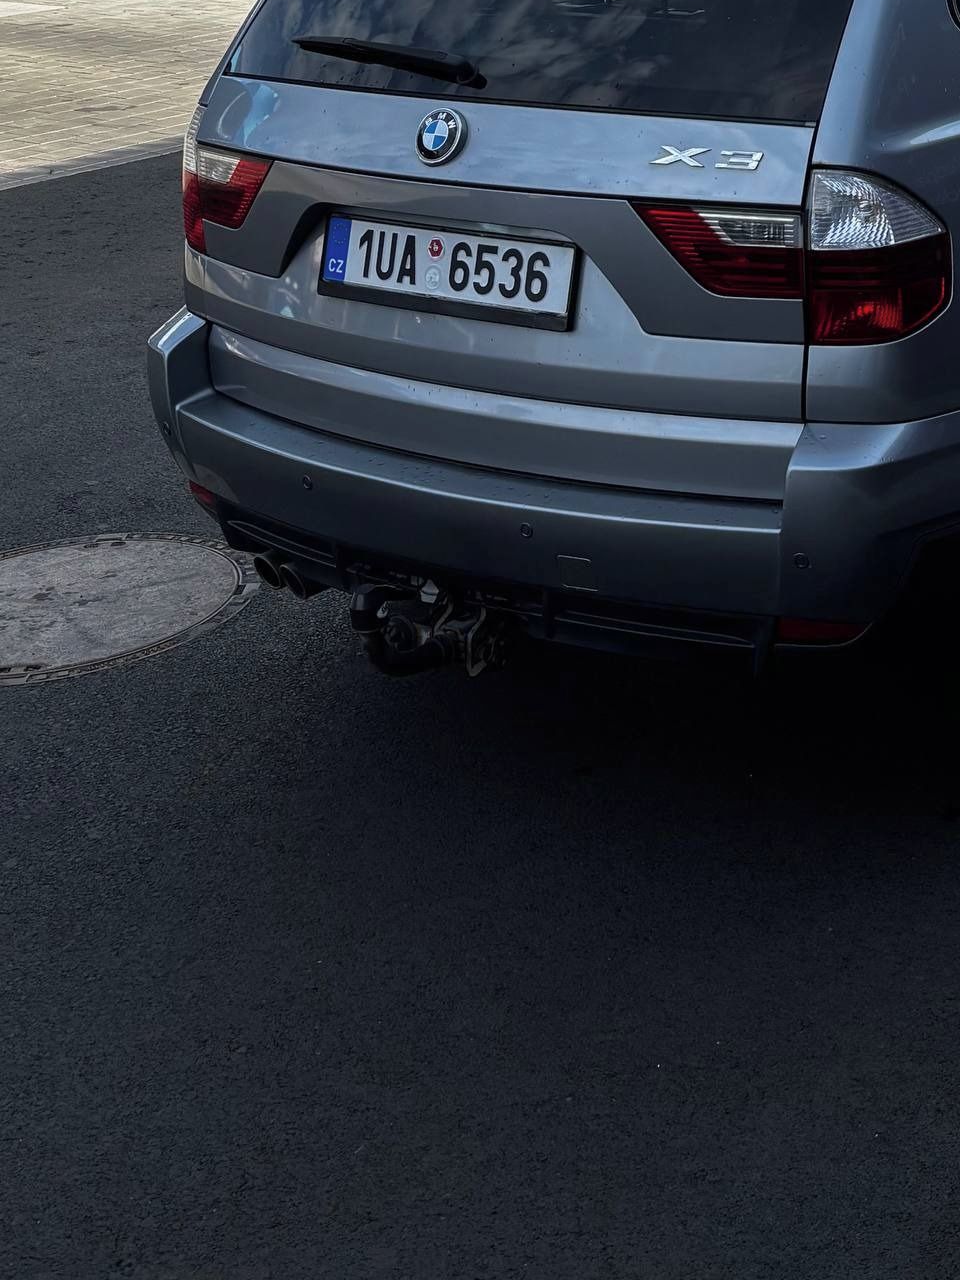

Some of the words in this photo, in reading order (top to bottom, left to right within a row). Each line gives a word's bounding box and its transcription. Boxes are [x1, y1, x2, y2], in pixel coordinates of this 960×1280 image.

[425, 112, 457, 129] BMW
[648, 145, 764, 171] X3
[328, 258, 344, 274] CZ
[358, 229, 417, 286] 1UA
[449, 241, 551, 303] 6536
